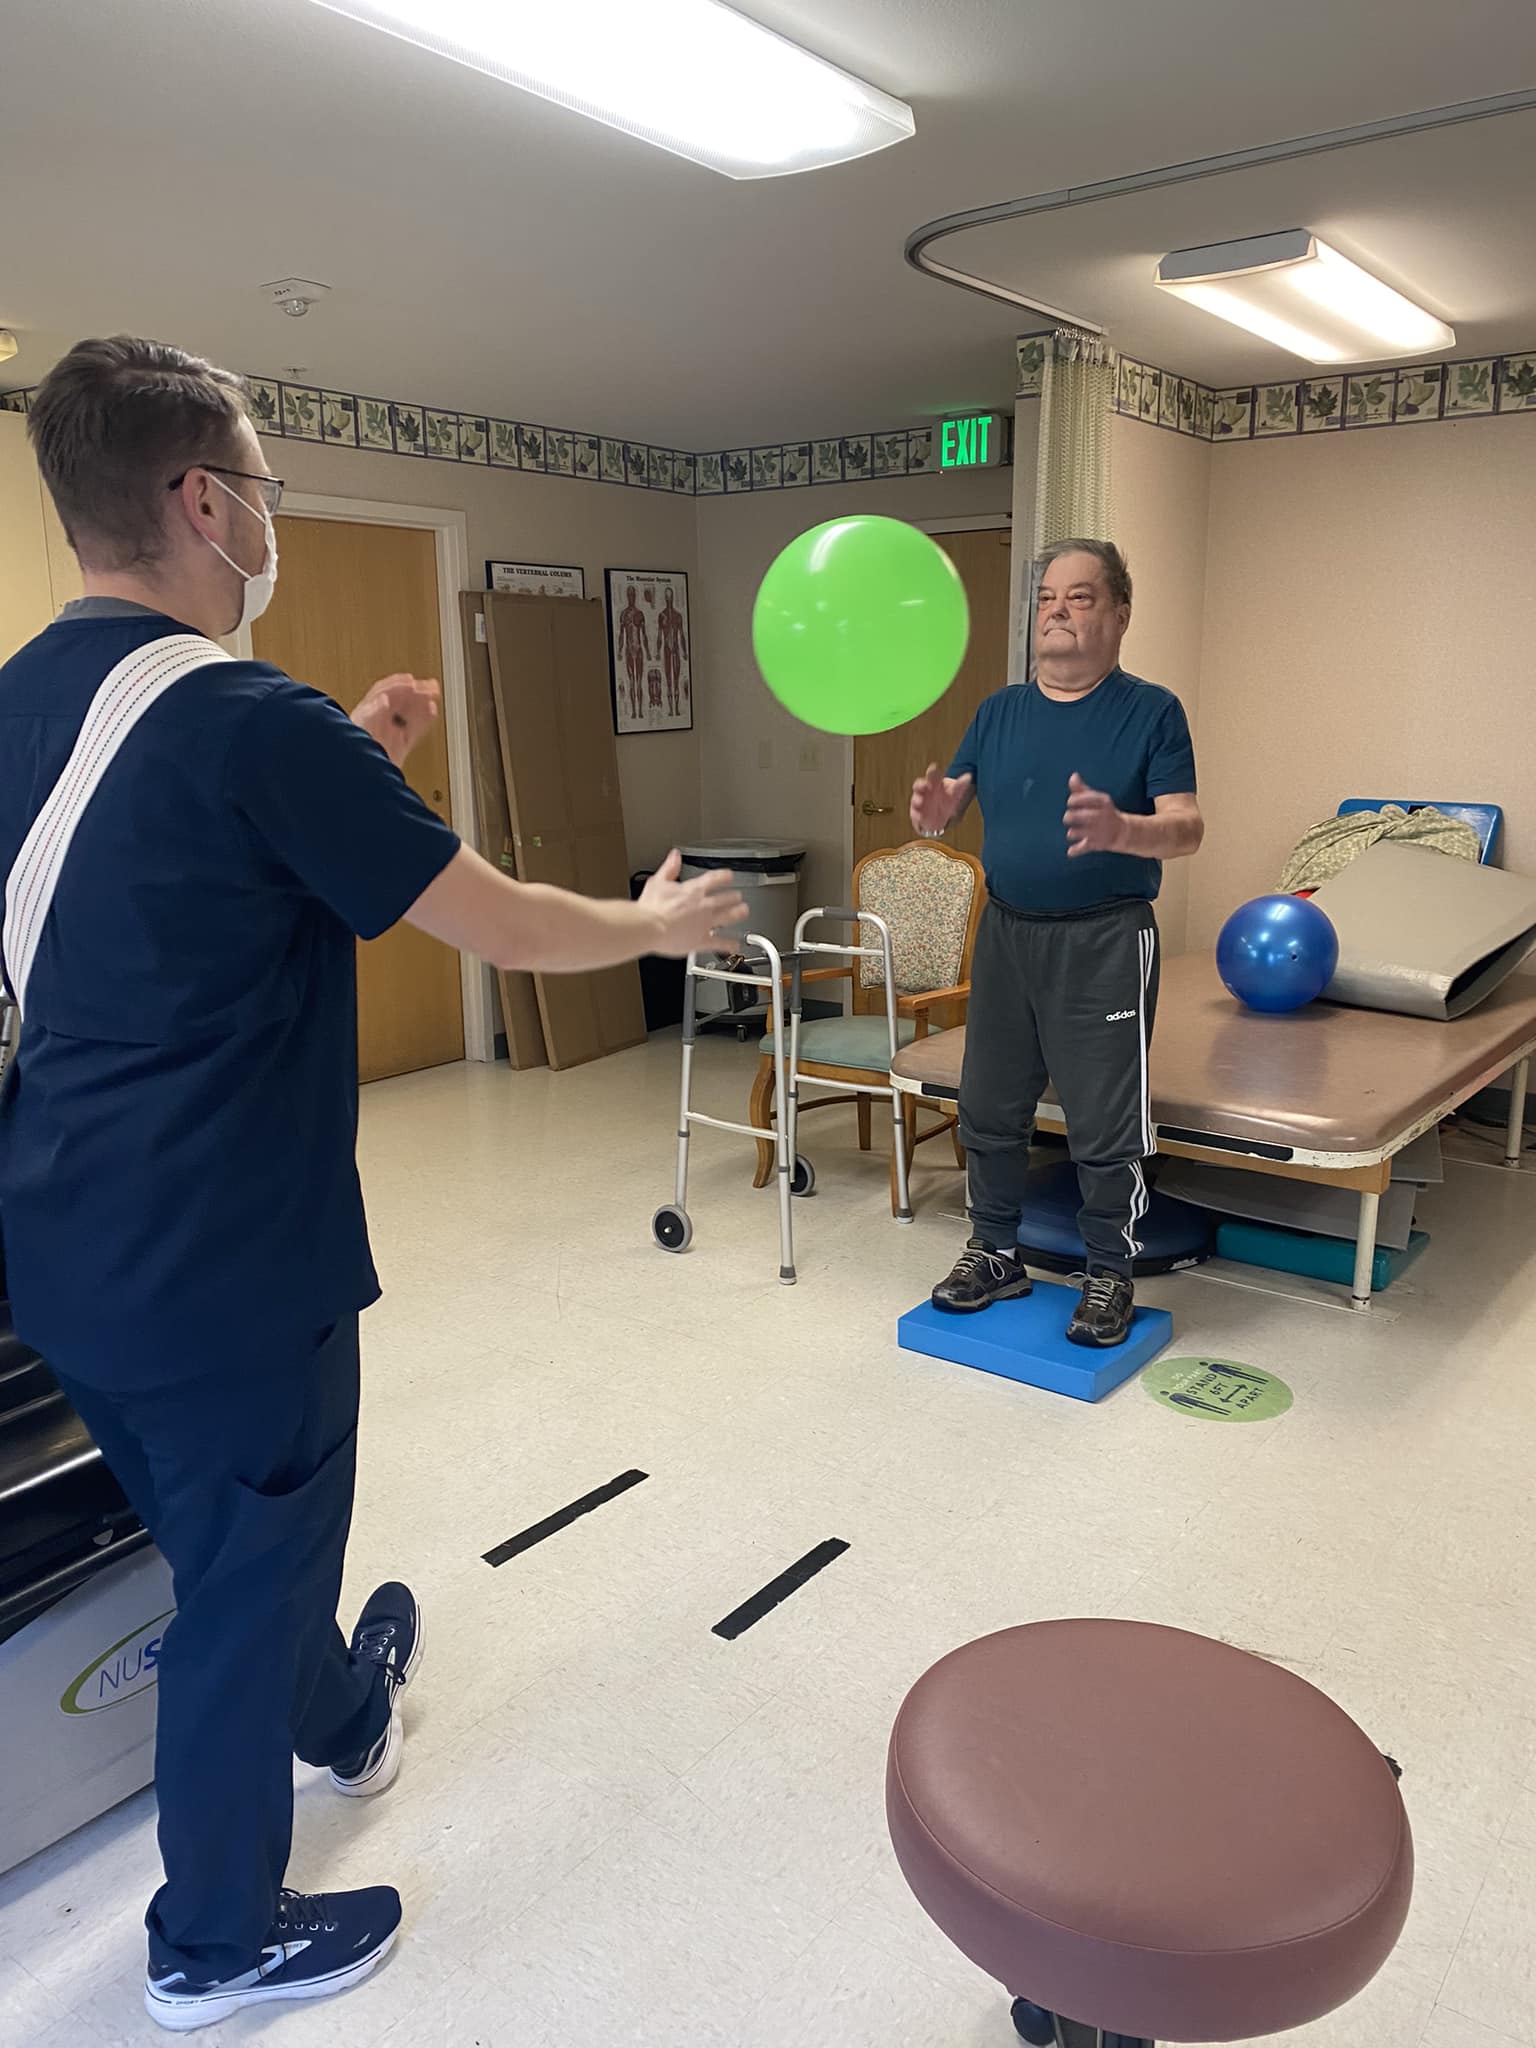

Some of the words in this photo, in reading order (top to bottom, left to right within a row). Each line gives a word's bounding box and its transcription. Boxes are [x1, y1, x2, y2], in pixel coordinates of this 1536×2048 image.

[942, 416, 992, 467] EXIT
[1106, 1009, 1136, 1021] adidas
[1186, 1373, 1217, 1395] STAND
[1209, 1382, 1229, 1396] 6FT
[1236, 1387, 1265, 1409] APART
